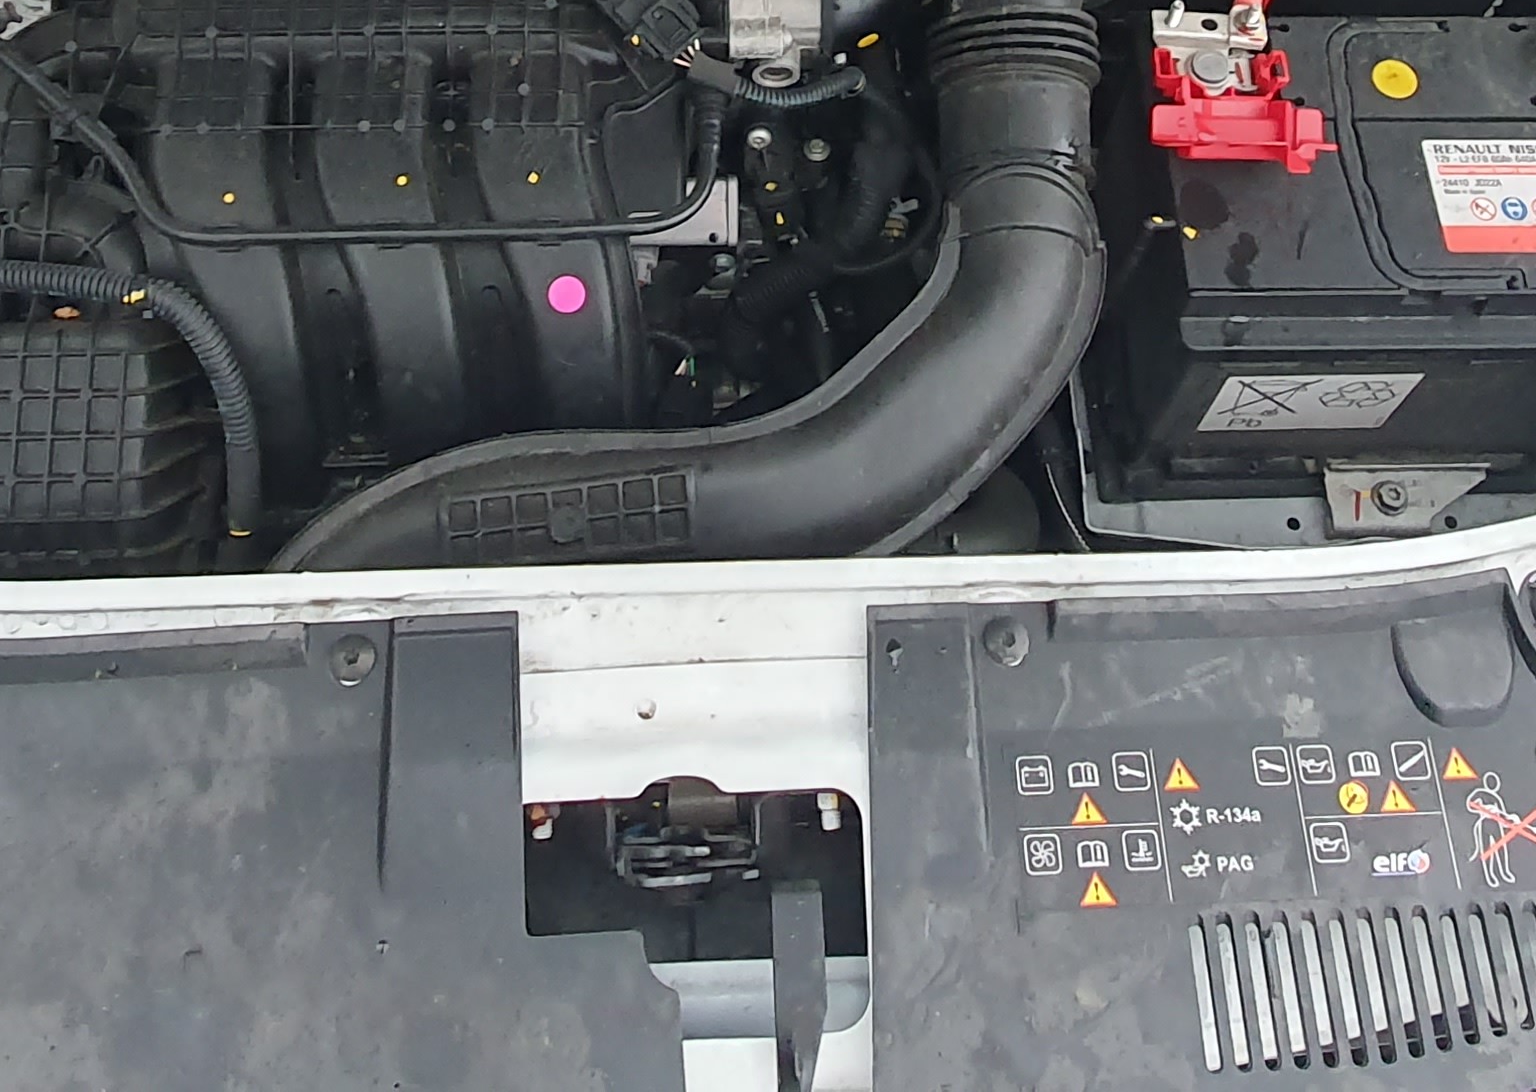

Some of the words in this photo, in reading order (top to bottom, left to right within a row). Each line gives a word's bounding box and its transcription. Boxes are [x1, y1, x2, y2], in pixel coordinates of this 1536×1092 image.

[1433, 144, 1501, 155] RENAULT
[1226, 417, 1263, 429] Pb
[1206, 807, 1262, 825] R-134a
[1216, 854, 1255, 873] PAG
[1373, 853, 1409, 873] elf
